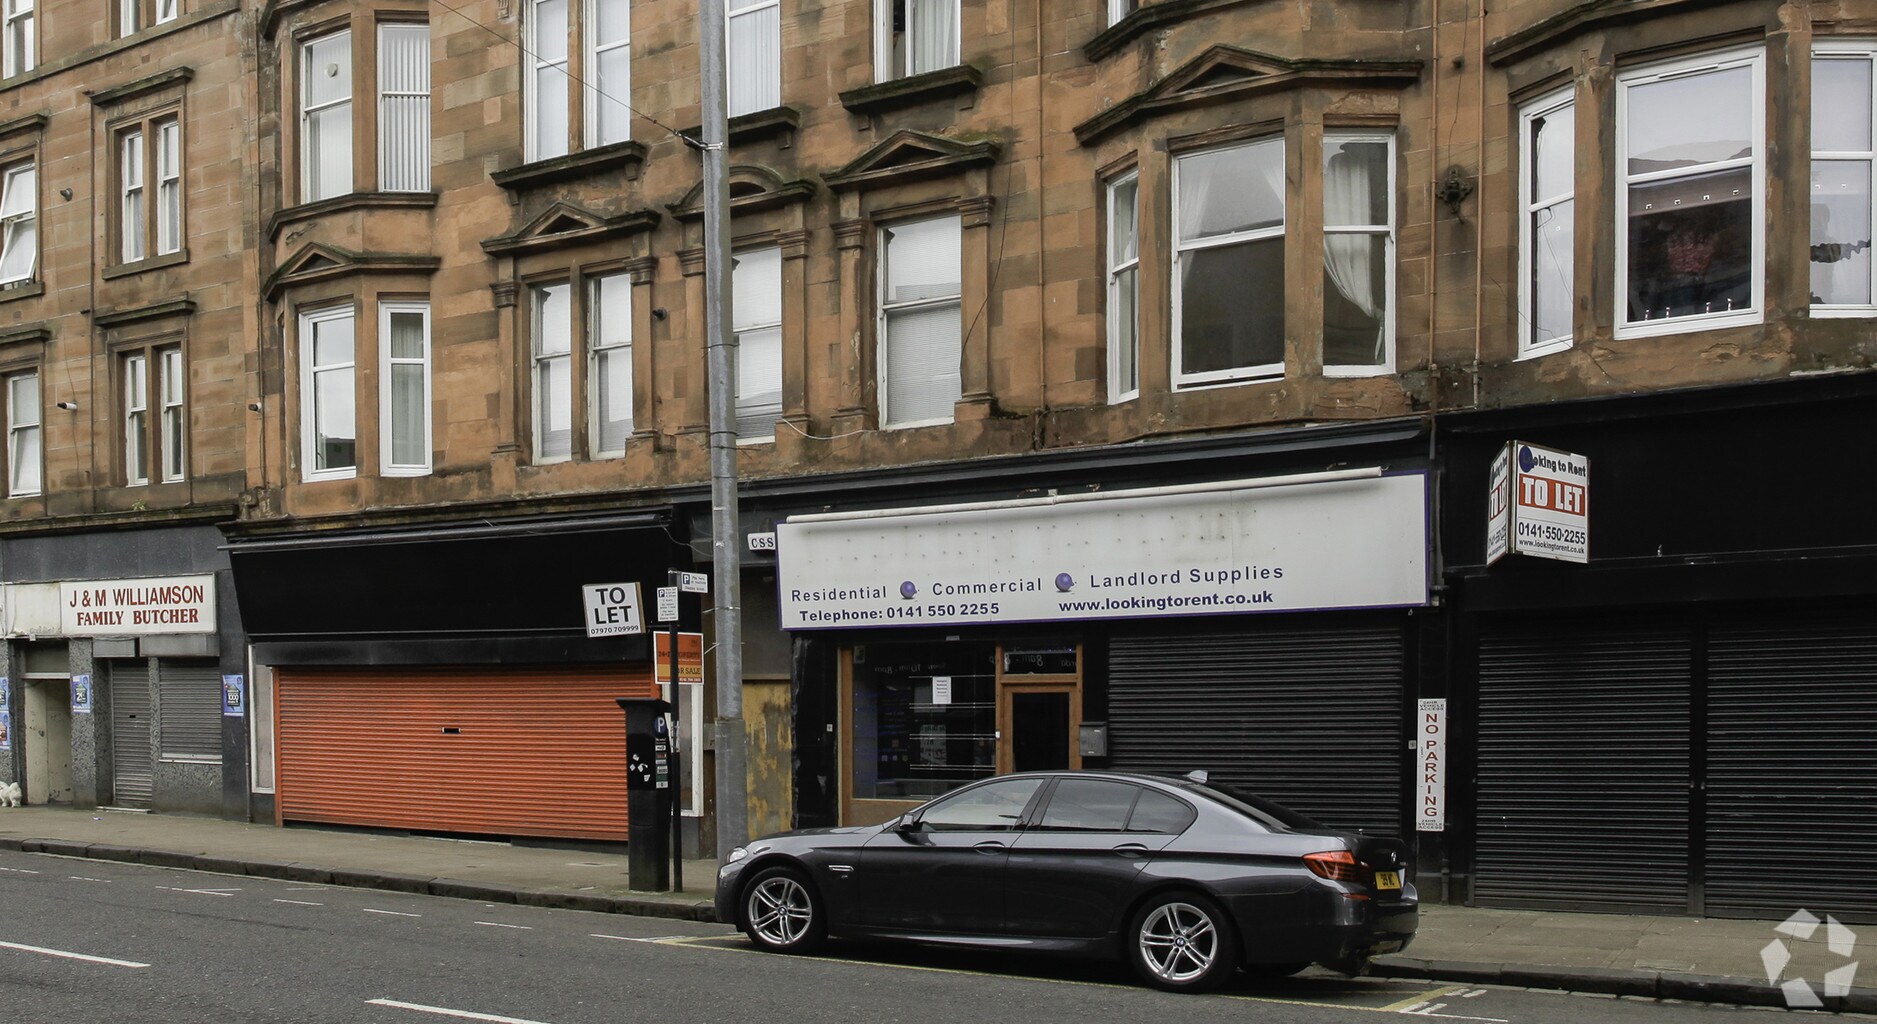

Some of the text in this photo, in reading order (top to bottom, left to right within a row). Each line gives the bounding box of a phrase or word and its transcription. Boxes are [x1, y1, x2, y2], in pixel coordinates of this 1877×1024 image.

[1558, 460, 1567, 472] to
[1568, 462, 1586, 477] Rent
[1522, 477, 1583, 513] TO LET
[792, 566, 1283, 602] Residential Commercial Landlord Supplies
[69, 584, 204, 608] J & M WILLIAMSON
[595, 586, 626, 605] TO
[1059, 590, 1274, 612] www.lookingtorent.co.uk
[76, 608, 199, 626] FAMILY BUTCHER
[594, 605, 632, 625] LET
[799, 602, 999, 623] Telephone: 0141 550 2255
[590, 627, 613, 635] 07970
[1425, 713, 1439, 734] NO
[1424, 740, 1439, 817] PARKING
